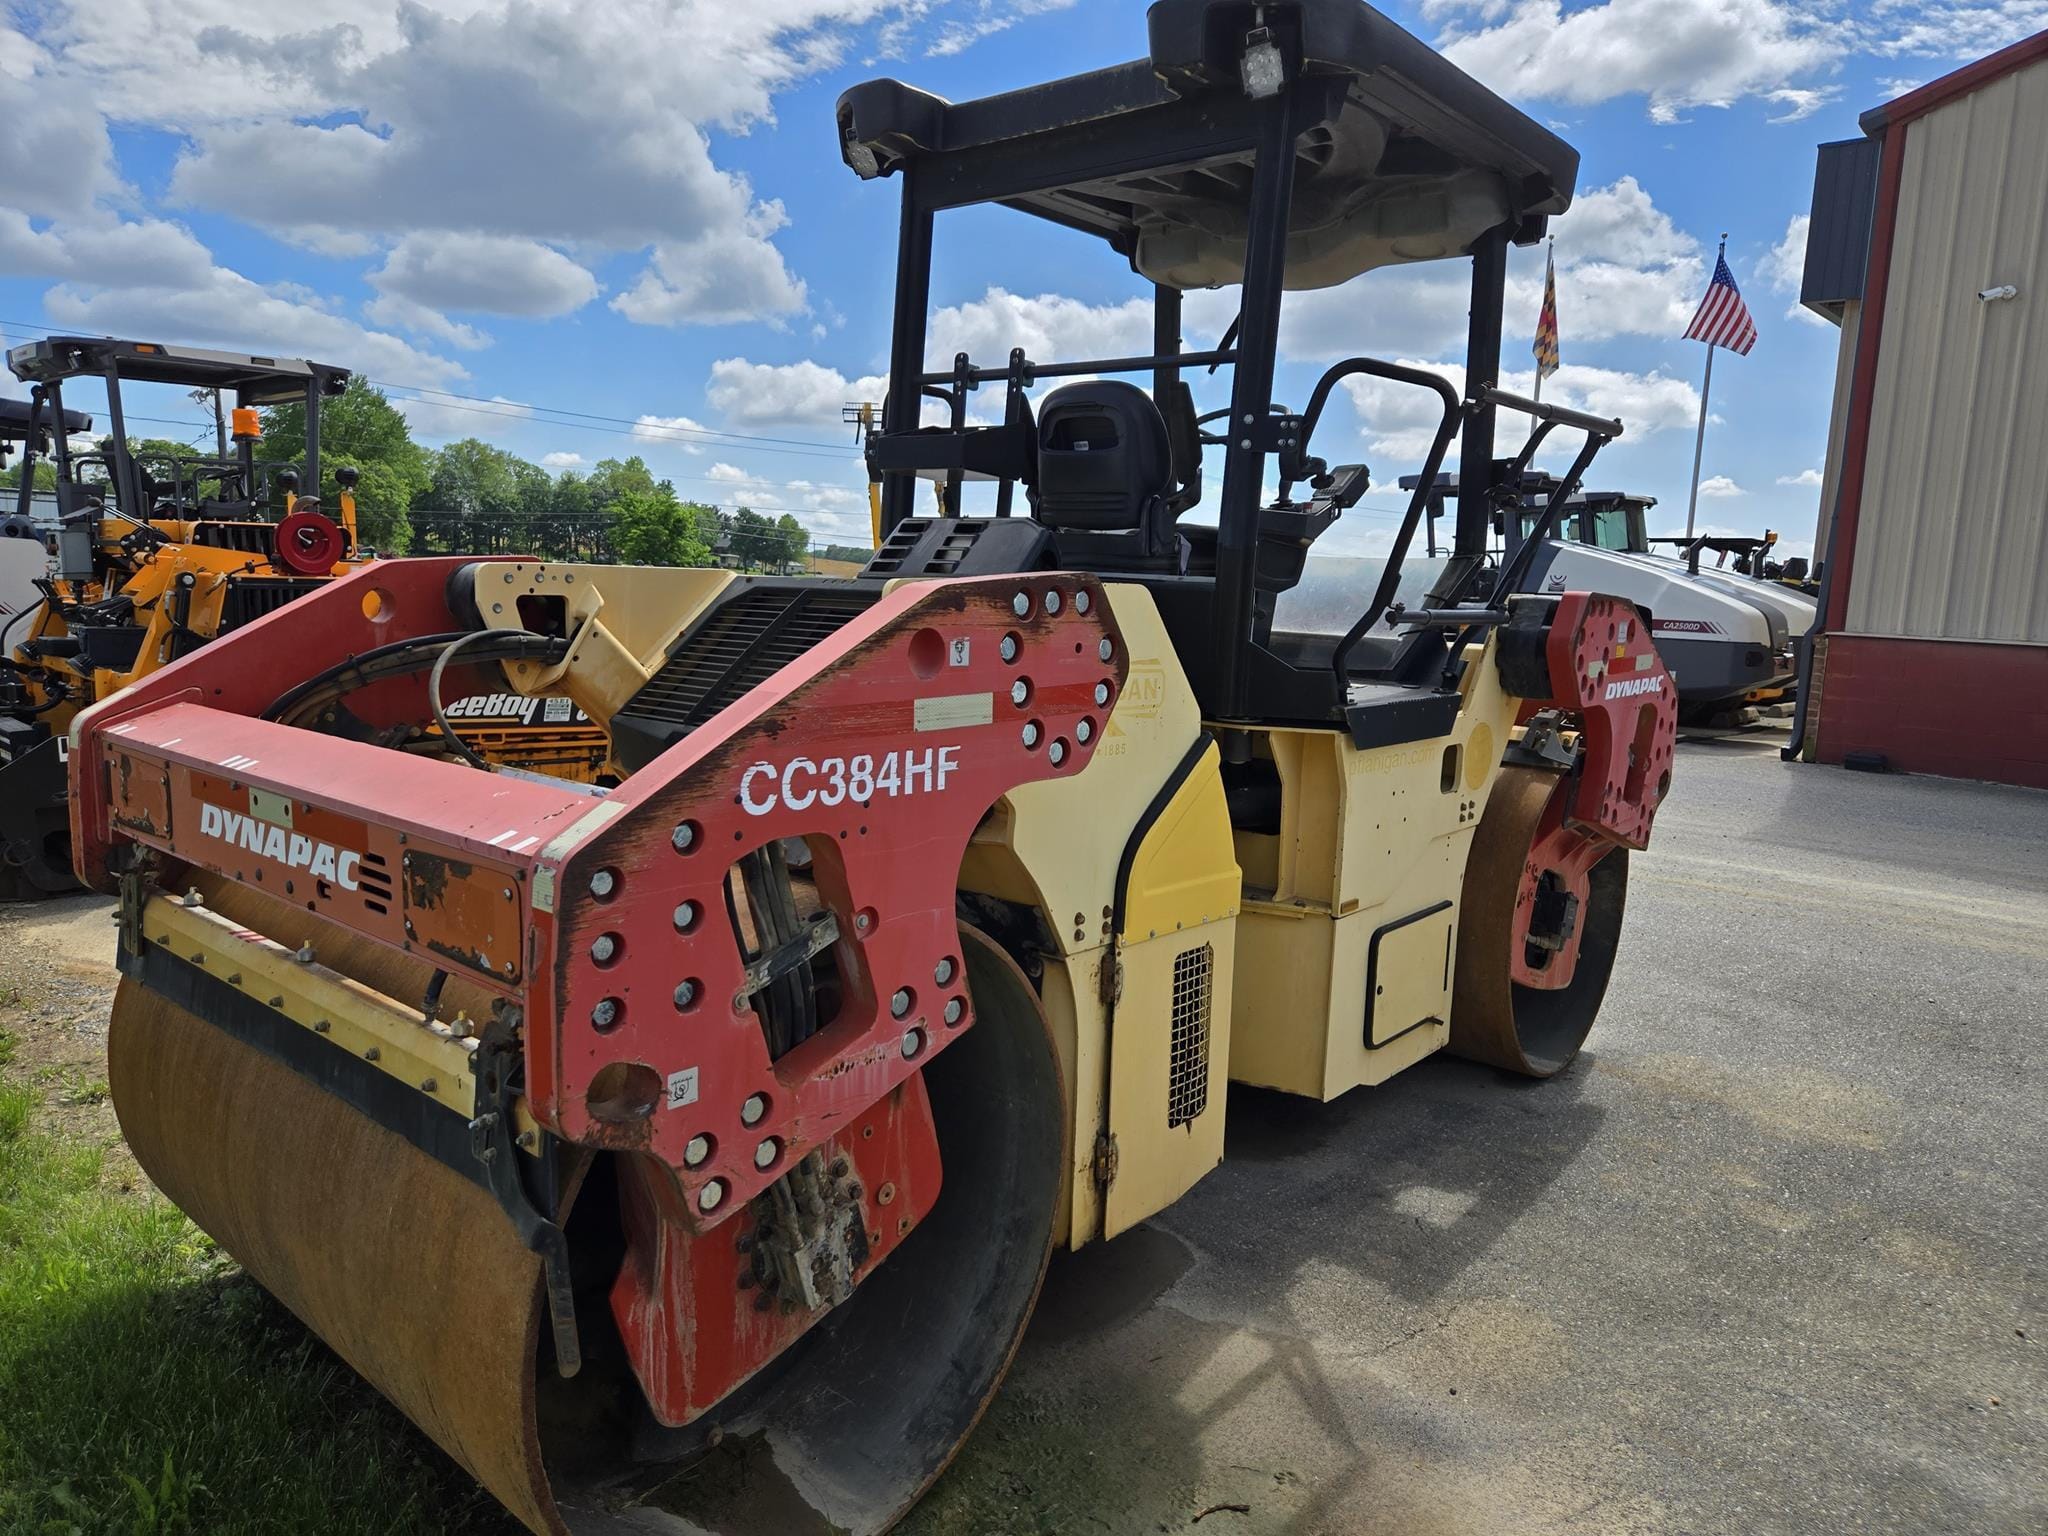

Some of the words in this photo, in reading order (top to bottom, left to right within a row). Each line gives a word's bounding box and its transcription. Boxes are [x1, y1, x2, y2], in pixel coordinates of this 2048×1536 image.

[1663, 621, 1700, 631] CA2500D
[1605, 675, 1664, 700] DYNAPAC
[740, 744, 962, 816] CC384HF
[201, 804, 360, 891] DYNAPAC
